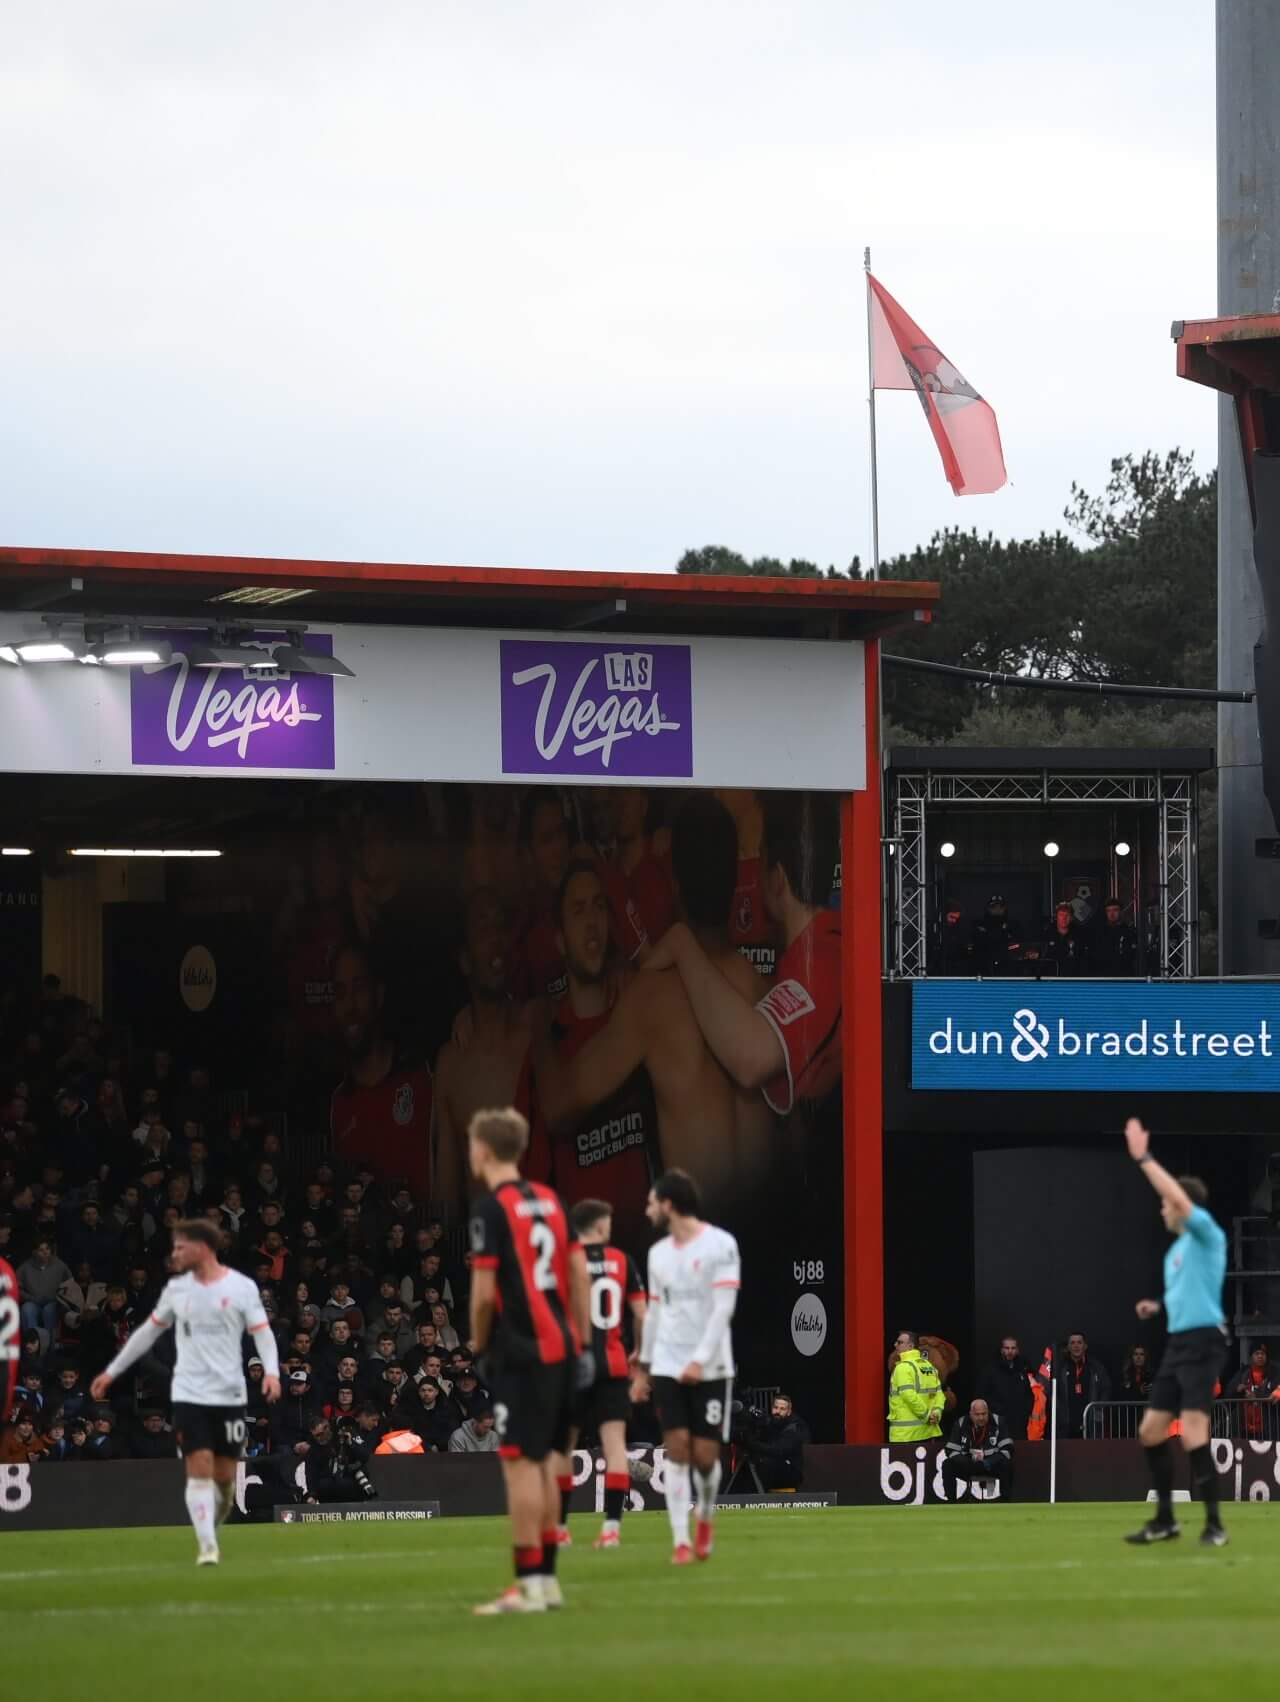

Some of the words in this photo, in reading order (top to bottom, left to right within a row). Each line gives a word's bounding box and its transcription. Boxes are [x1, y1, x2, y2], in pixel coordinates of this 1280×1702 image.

[608, 655, 650, 688] LAS
[143, 652, 322, 760] Vegas
[512, 659, 681, 768] Vegas
[577, 1112, 643, 1151] carbrin
[529, 1221, 557, 1292] 2
[793, 1259, 825, 1285] bj88
[590, 1276, 622, 1331] 0
[794, 1311, 824, 1338] Vitality
[706, 1399, 722, 1425] 8
[225, 1419, 246, 1443] 10
